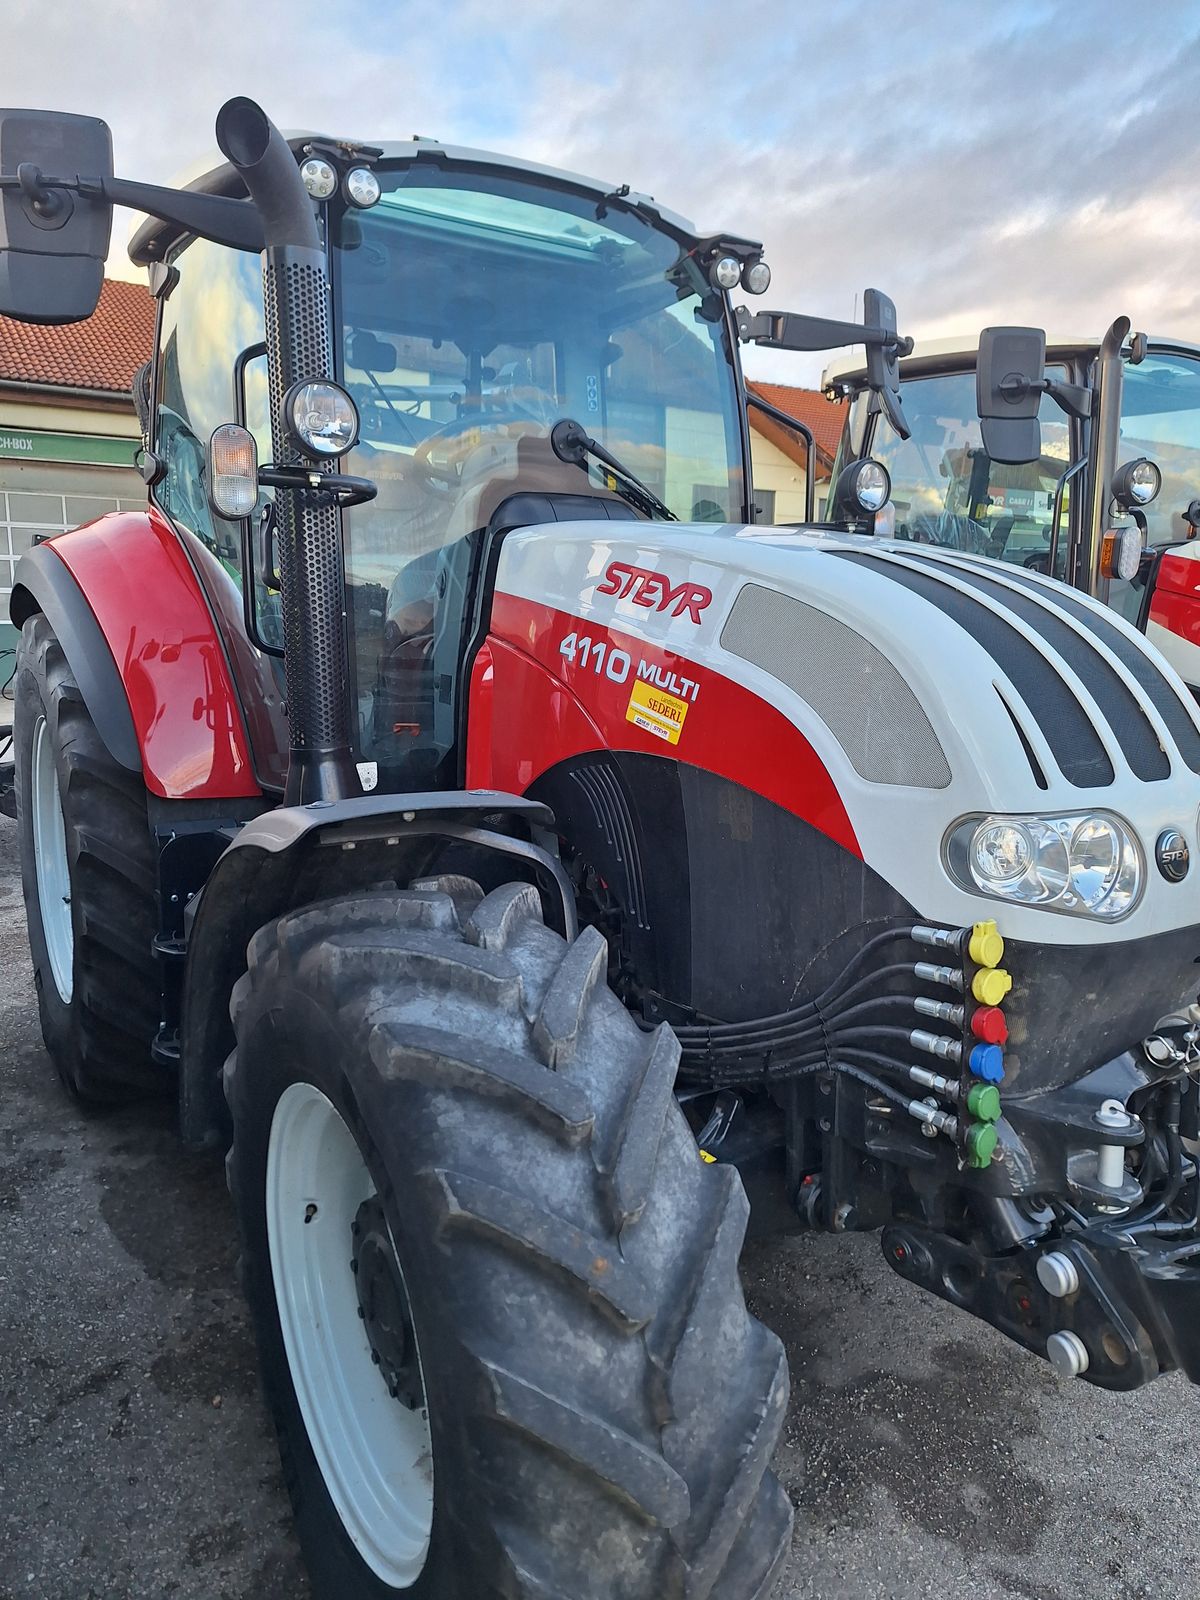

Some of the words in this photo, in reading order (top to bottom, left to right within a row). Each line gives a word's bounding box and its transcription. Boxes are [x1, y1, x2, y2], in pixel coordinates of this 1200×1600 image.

[596, 561, 712, 625] STEYR
[559, 632, 632, 684] 4110
[637, 659, 700, 702] MULTI
[647, 697, 682, 724] SEDERL
